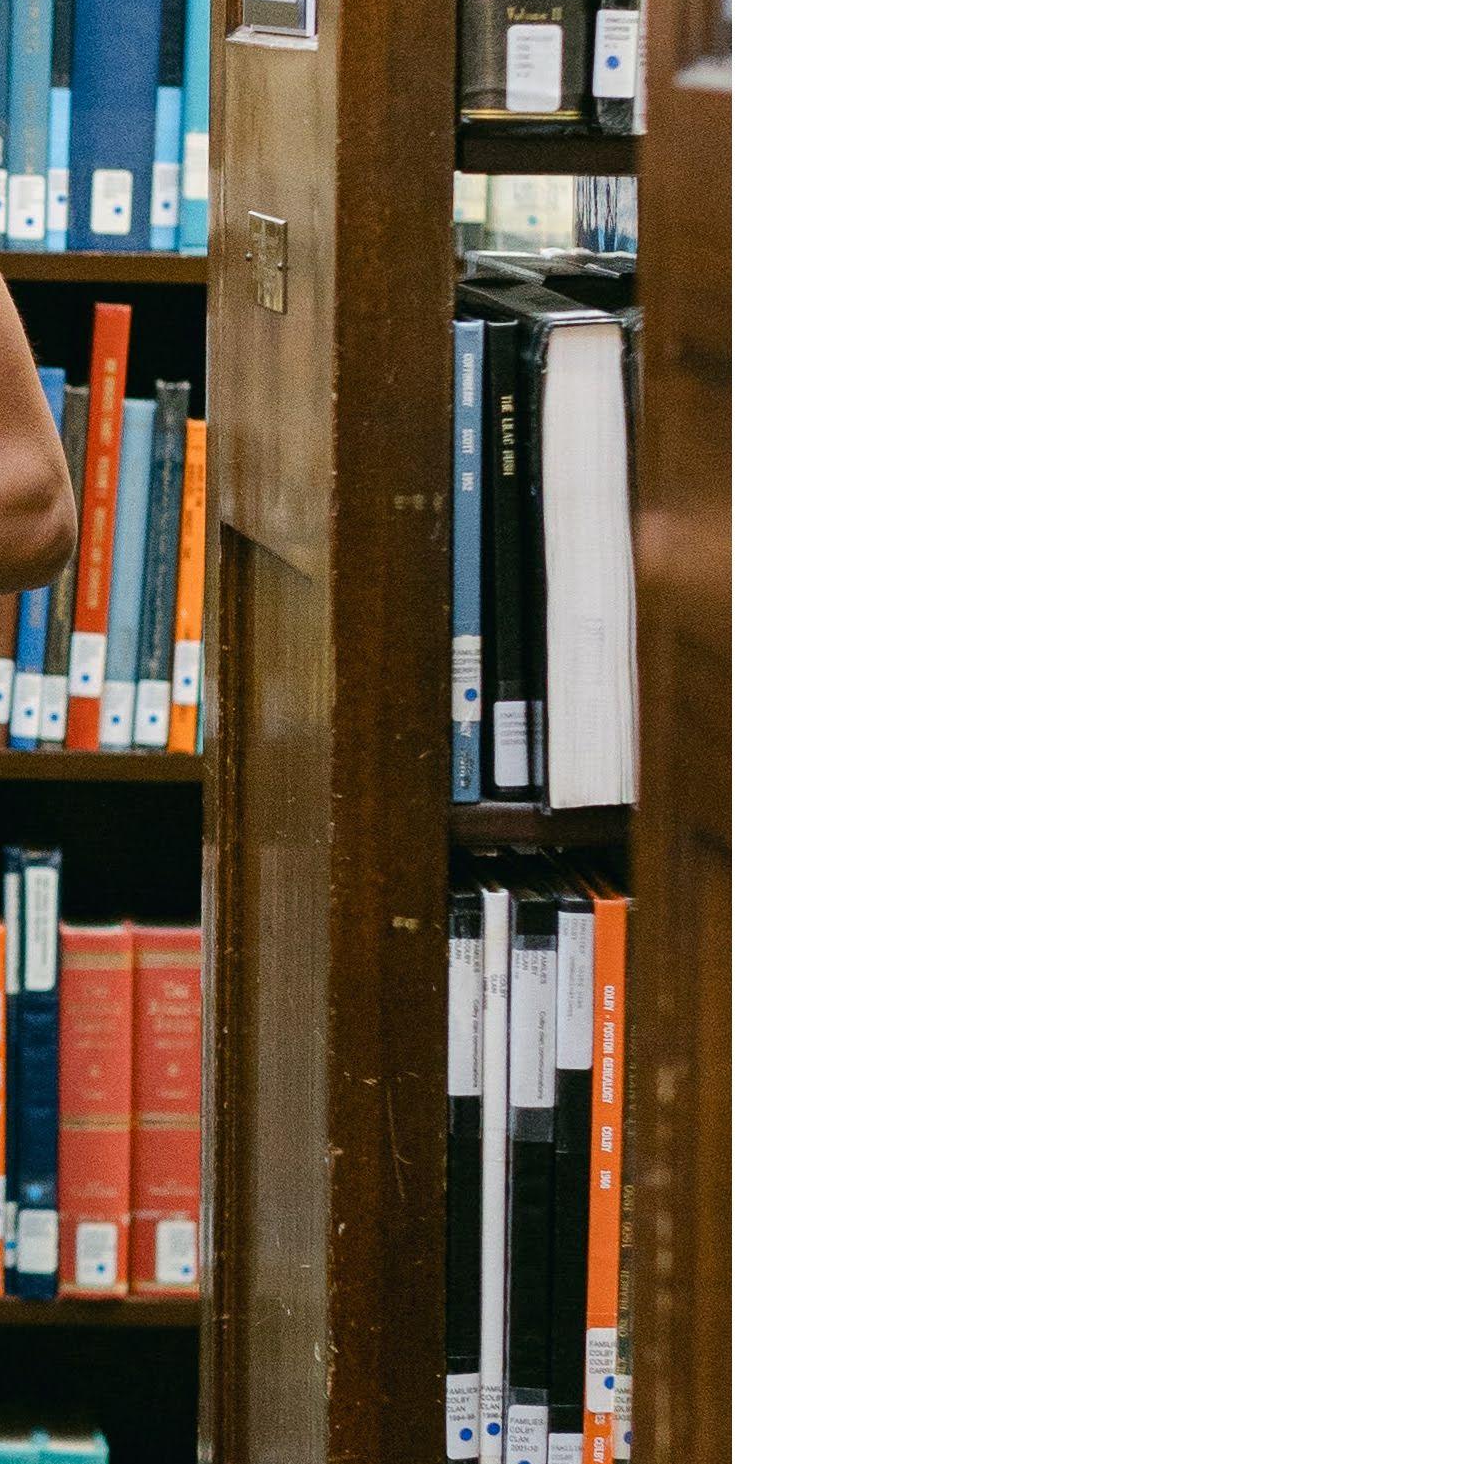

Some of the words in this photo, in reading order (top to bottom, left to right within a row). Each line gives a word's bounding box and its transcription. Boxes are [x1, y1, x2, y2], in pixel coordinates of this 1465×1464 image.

[603, 985, 616, 1012] COLBY
[602, 1057, 616, 1104] GENEALOGY
[601, 1126, 614, 1153] COLBY
[509, 1418, 544, 1426] FAMILIES
[509, 1427, 536, 1435] COLBY
[509, 1435, 529, 1444] CLAN
[593, 1437, 605, 1464] COLBY
